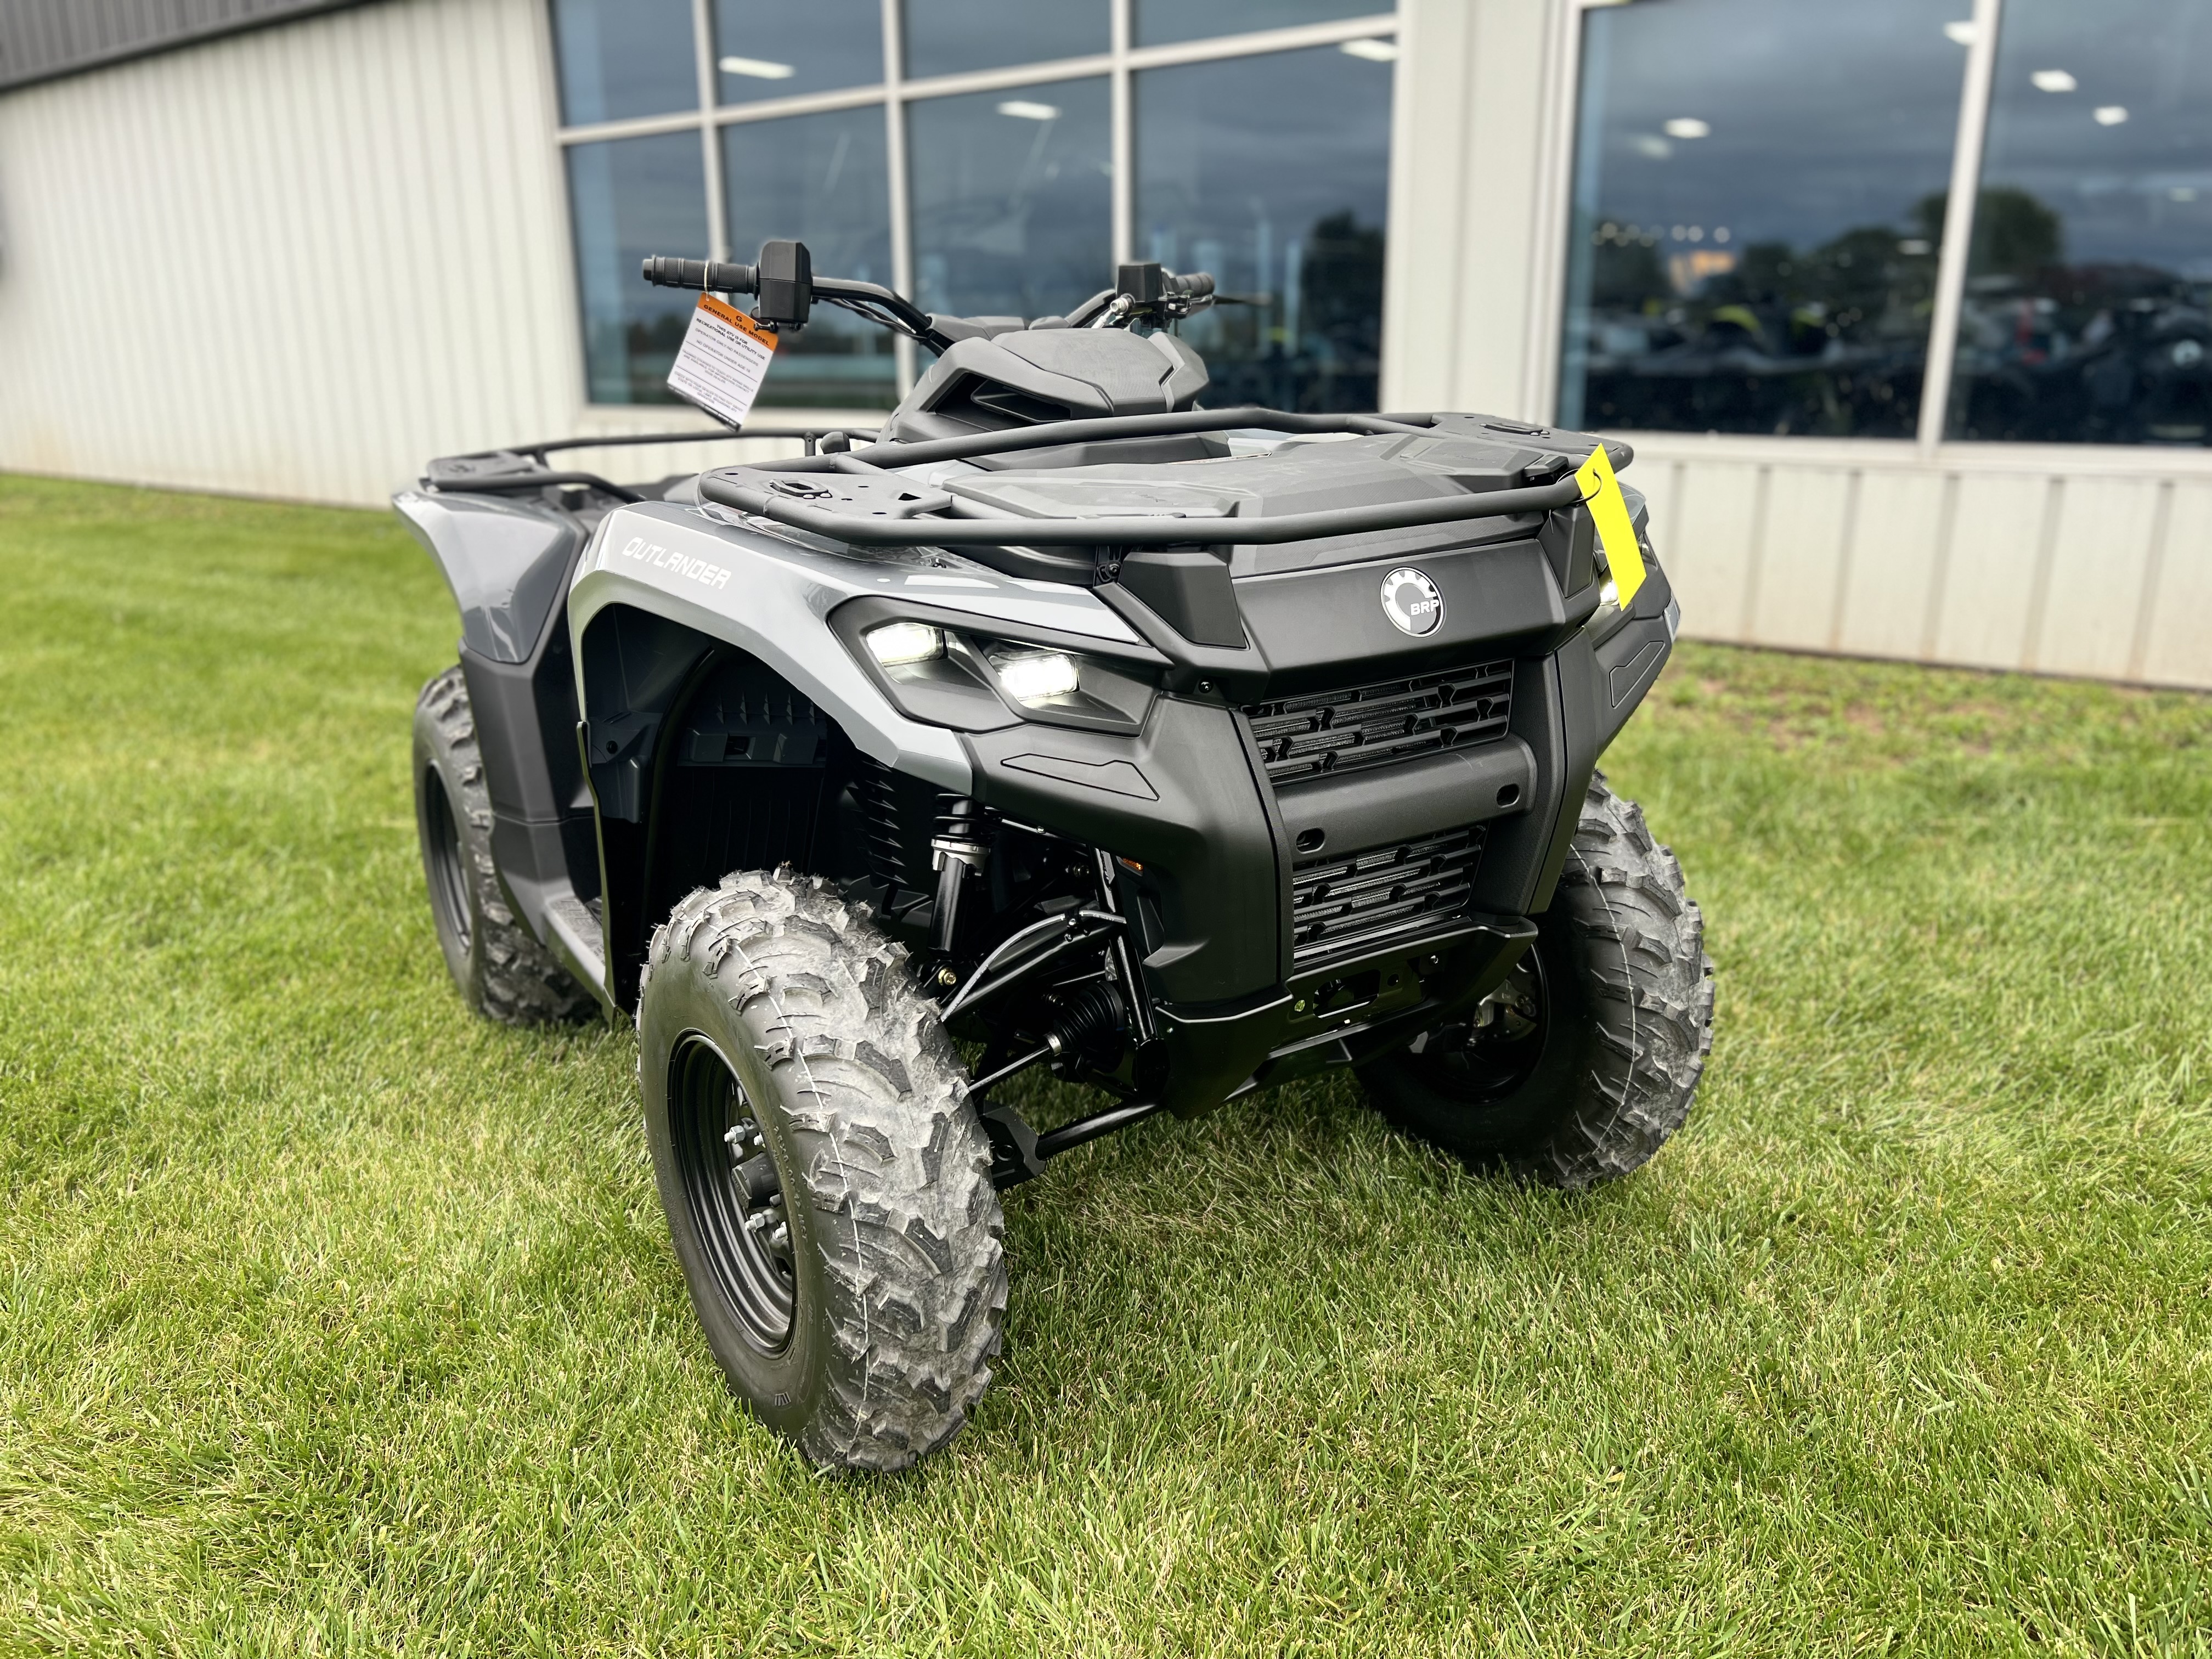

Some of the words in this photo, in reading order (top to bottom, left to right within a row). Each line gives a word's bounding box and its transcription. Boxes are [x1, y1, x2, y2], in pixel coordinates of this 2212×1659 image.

[703, 303, 733, 324] GENERAL
[733, 321, 747, 332] USE
[747, 329, 770, 346] MODEL
[716, 324, 726, 332] THIS
[735, 314, 743, 323] G
[695, 327, 716, 342] OPERATOR
[733, 349, 759, 366] PASSENGERS
[696, 317, 726, 337] RECREATIONAL
[741, 343, 757, 356] UTILITY
[702, 342, 724, 357] OPERATOR
[723, 354, 737, 365] UNDER
[622, 537, 732, 590] OUTLANDER
[1410, 599, 1440, 616] BRP
